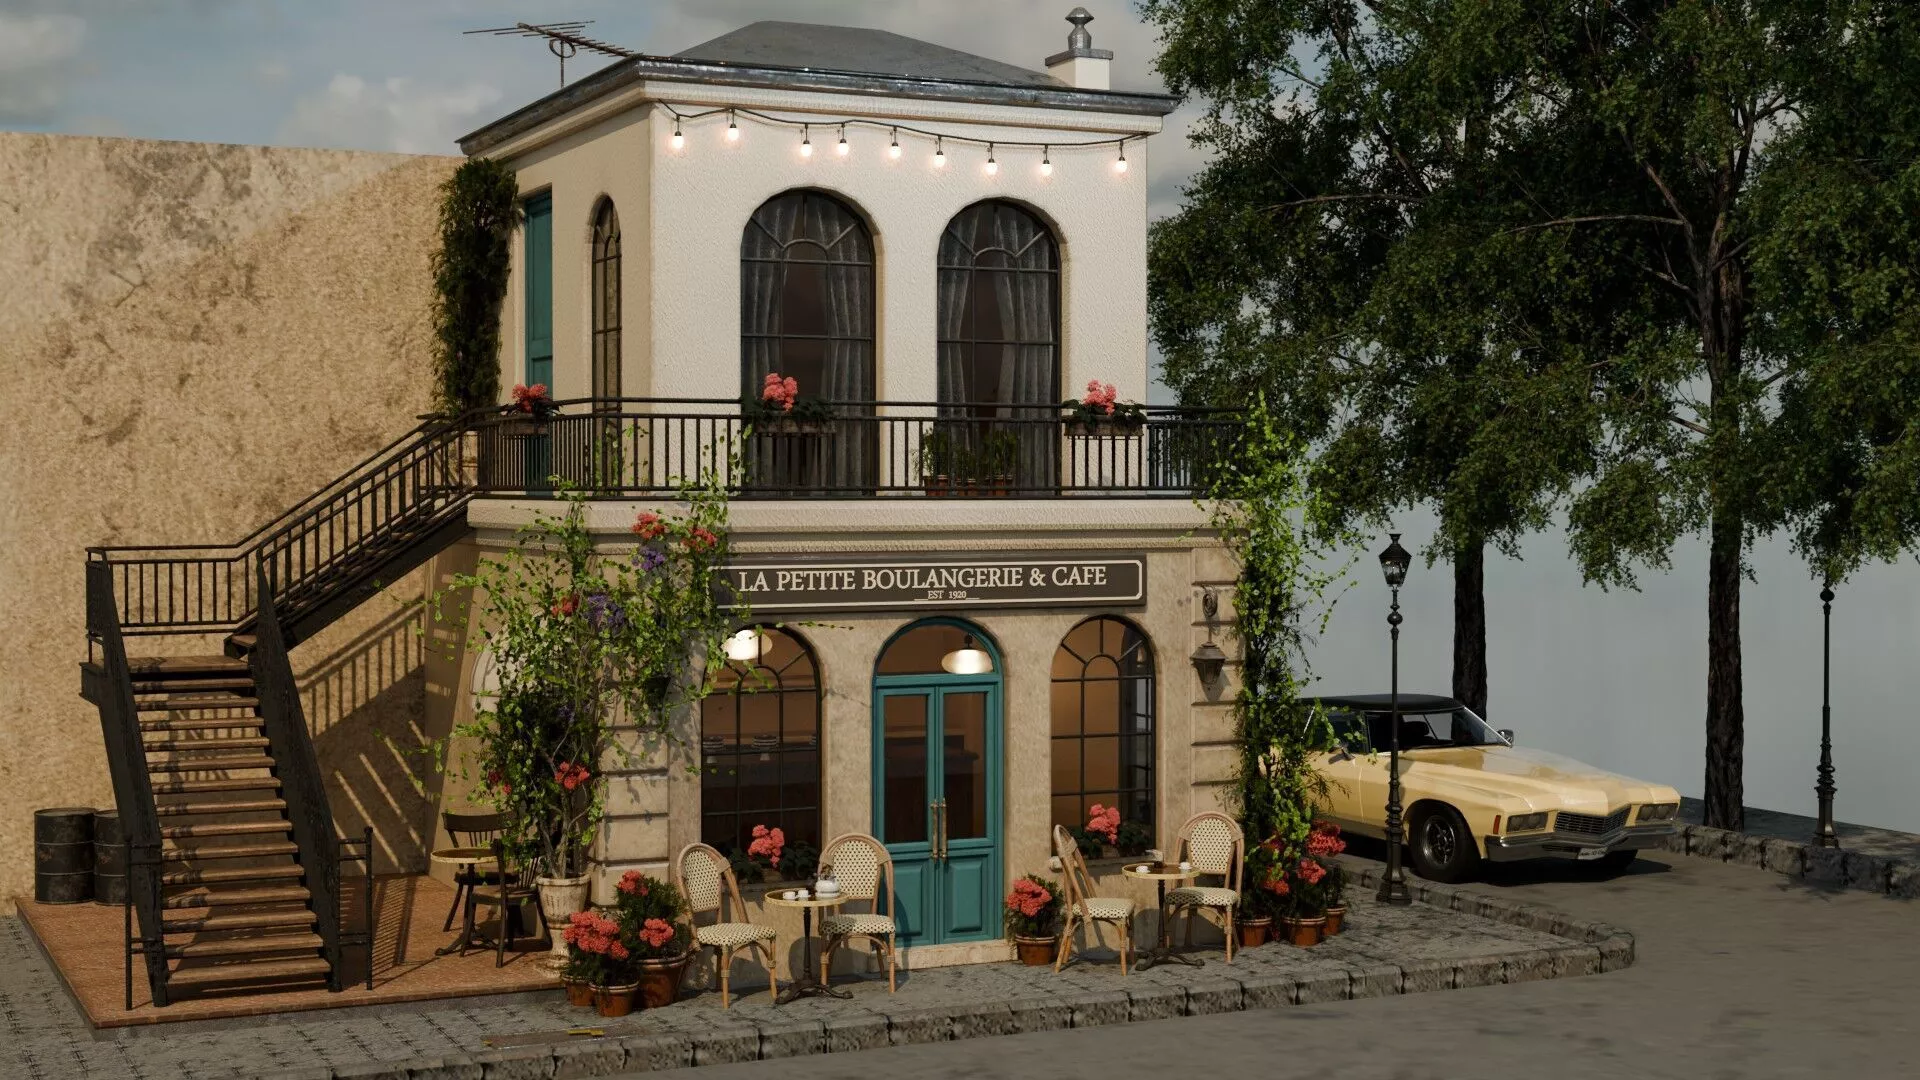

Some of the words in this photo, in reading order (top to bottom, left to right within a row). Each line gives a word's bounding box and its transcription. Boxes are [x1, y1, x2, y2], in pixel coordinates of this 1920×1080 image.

[739, 571, 770, 592] LA
[776, 569, 856, 591] PETITE
[862, 567, 1023, 590] BOULANGERIE
[1029, 567, 1046, 587] &
[1051, 566, 1107, 586] CAFE
[927, 590, 944, 599] EST
[948, 590, 967, 599] 1920
